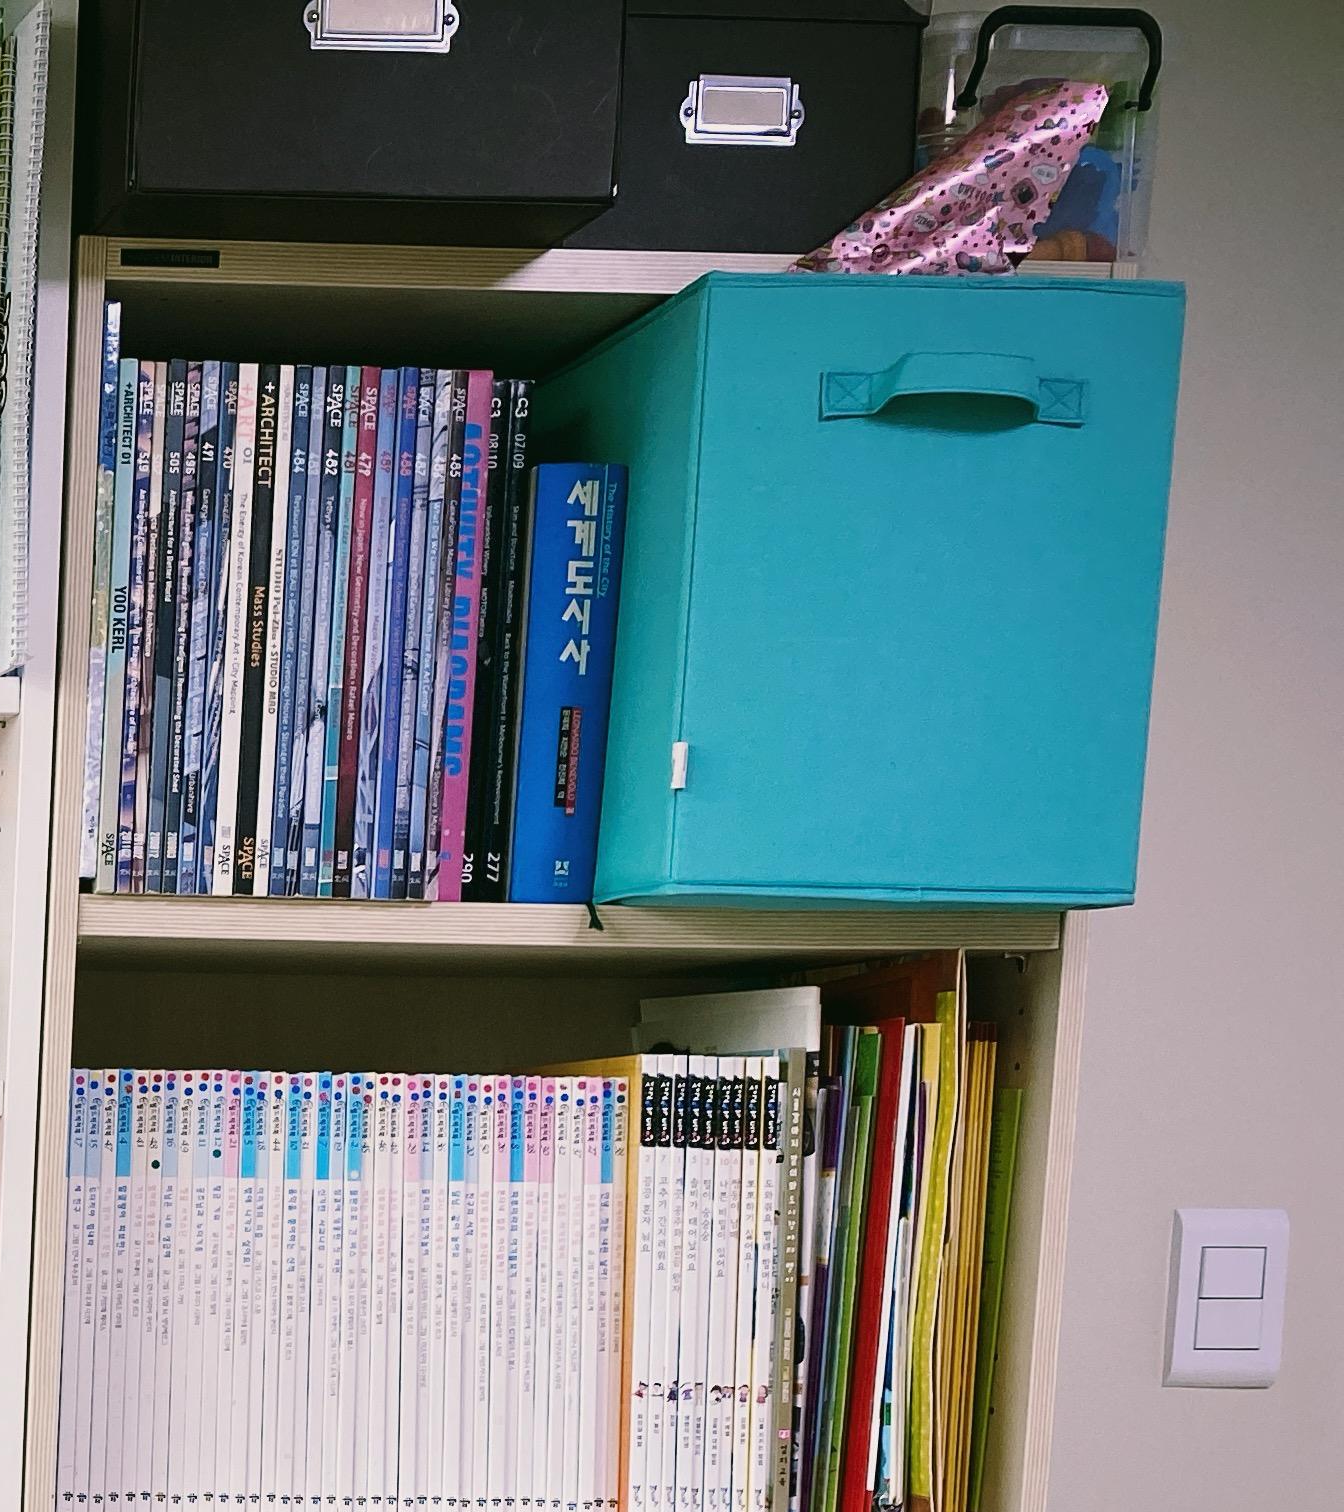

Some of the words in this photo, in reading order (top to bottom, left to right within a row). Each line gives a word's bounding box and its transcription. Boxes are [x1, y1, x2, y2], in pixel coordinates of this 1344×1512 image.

[296, 383, 309, 417] SPACE
[327, 384, 343, 427] SPACE
[360, 387, 377, 430] SPACE
[453, 388, 466, 422] SPACE
[515, 397, 528, 418] C3
[258, 382, 275, 488] +ARCHITECT
[169, 451, 180, 474] 505
[293, 449, 304, 473] 484
[325, 449, 337, 476] 482
[450, 453, 461, 478] 485
[559, 480, 600, 676] 세계도시사
[114, 586, 127, 614] YOO
[252, 586, 266, 619] Mass
[250, 621, 264, 668] Studies
[101, 833, 115, 866] SPACE
[218, 844, 231, 875] SPACE
[237, 837, 254, 879] SPACE
[257, 839, 269, 868] SPACE
[487, 851, 500, 882] 277
